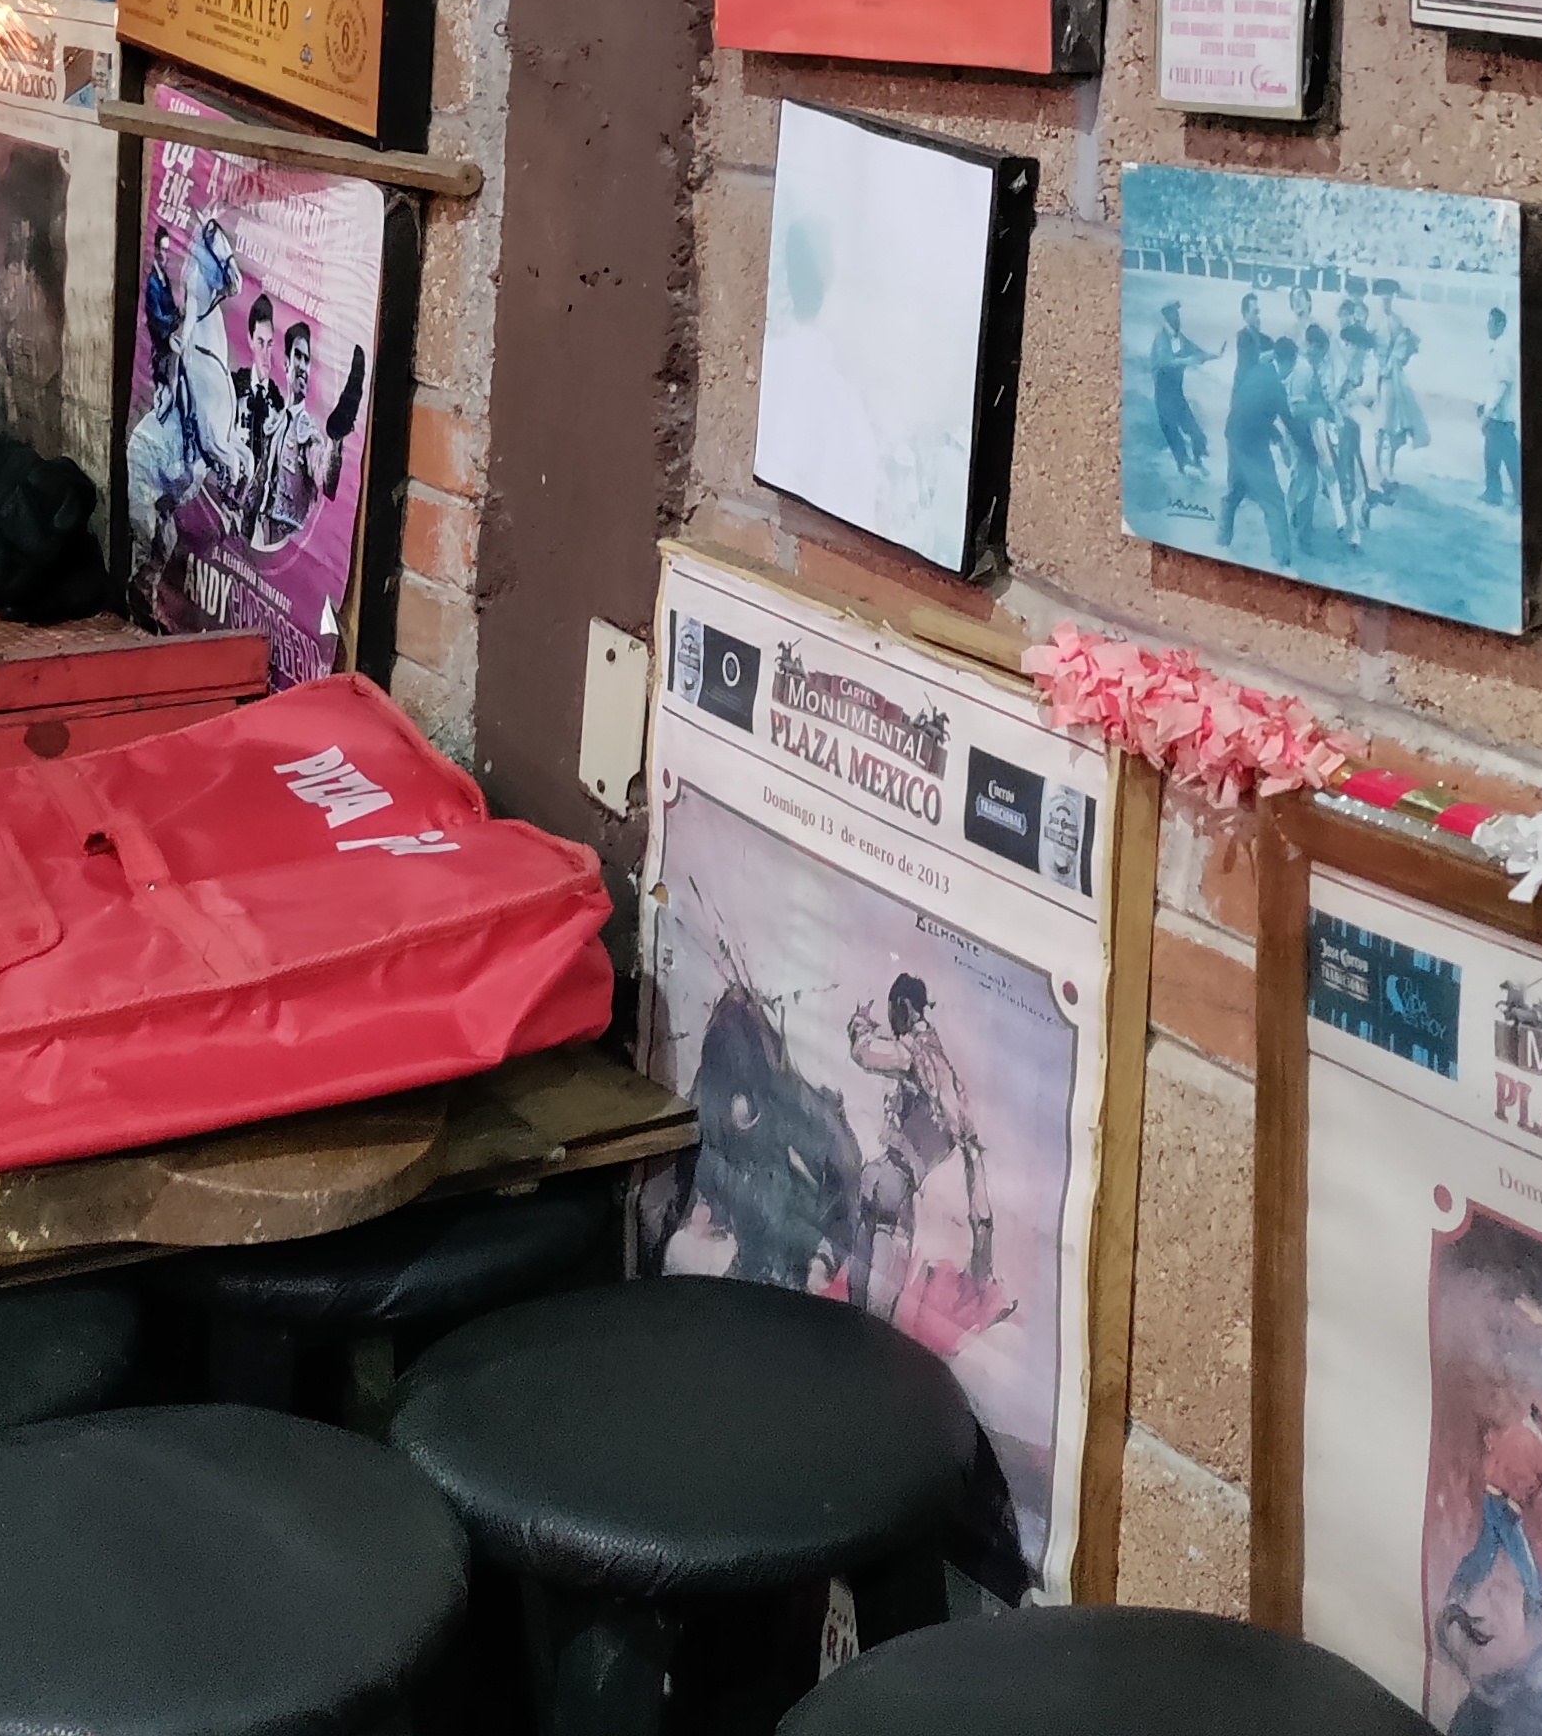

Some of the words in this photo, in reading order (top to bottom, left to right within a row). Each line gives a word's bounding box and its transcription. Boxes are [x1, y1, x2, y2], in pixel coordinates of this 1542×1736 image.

[183, 552, 233, 625] ANDY
[769, 707, 843, 780] PLAZA
[847, 745, 943, 827] MEXICO
[787, 676, 928, 768] MONUMENTAL
[762, 785, 817, 829] Domingo
[819, 815, 835, 836] 13
[840, 824, 857, 847] de
[858, 836, 895, 868] enero
[897, 854, 914, 877] de
[917, 863, 951, 895] 2013
